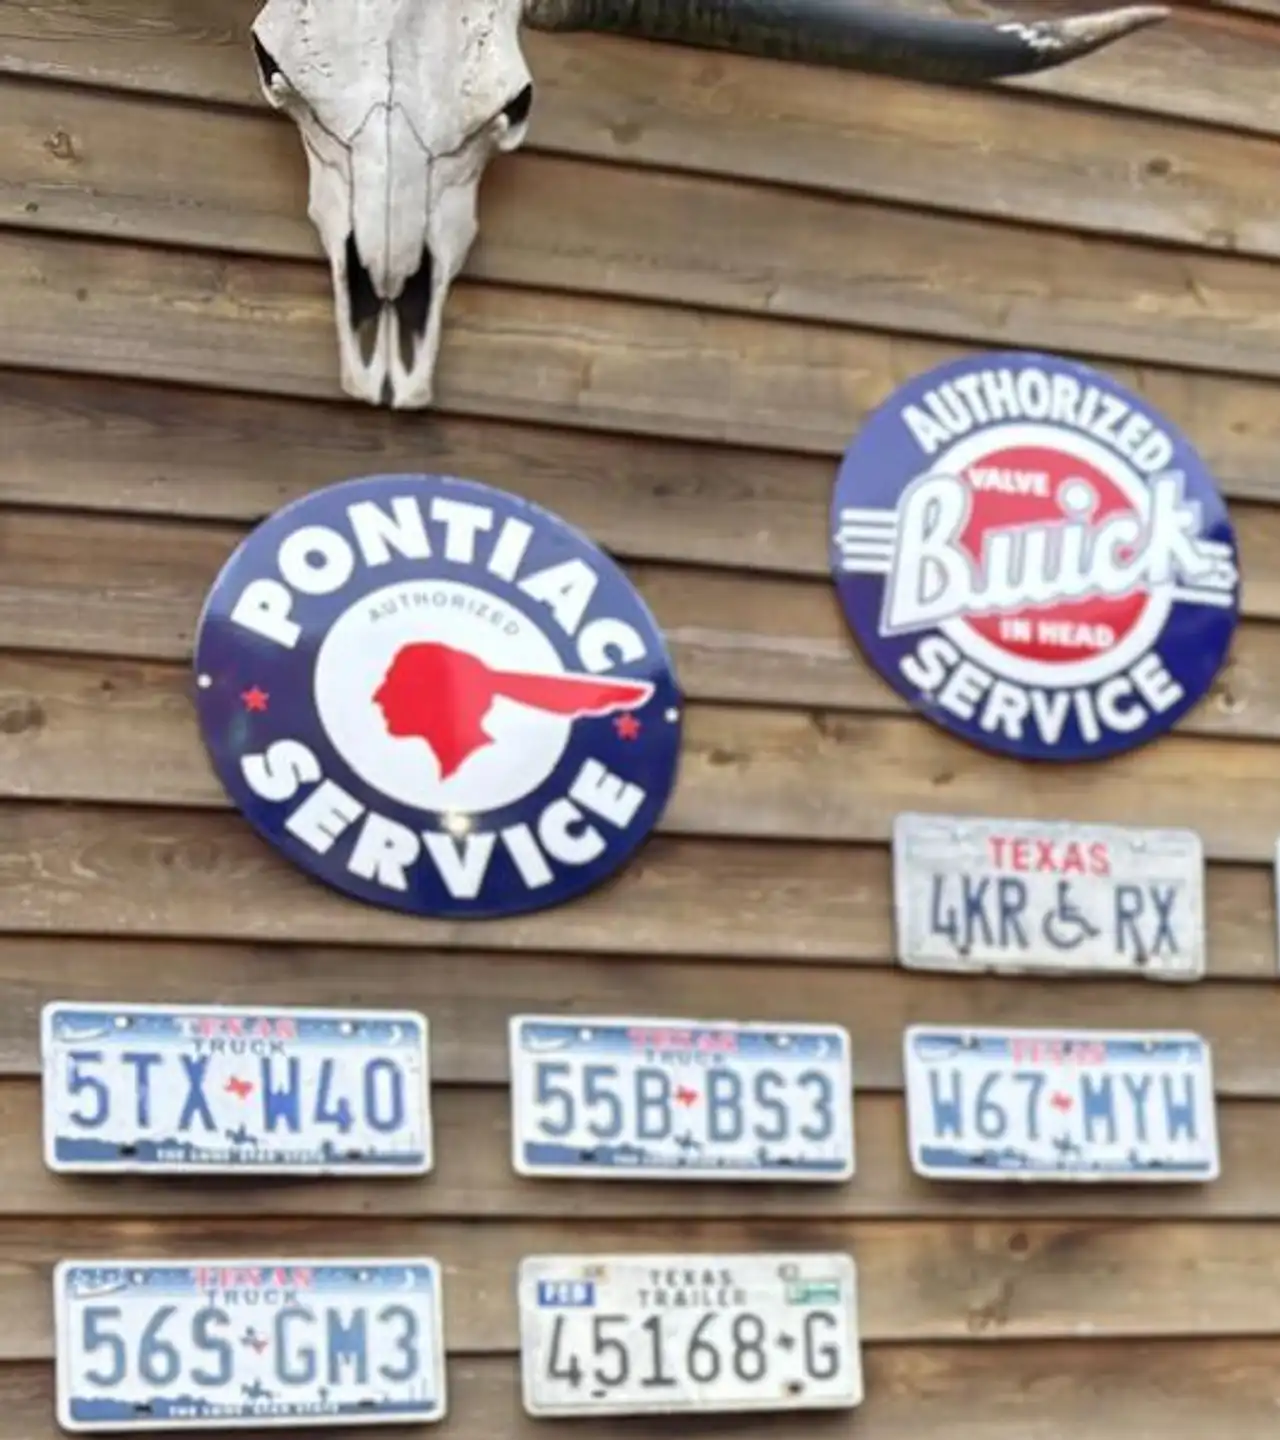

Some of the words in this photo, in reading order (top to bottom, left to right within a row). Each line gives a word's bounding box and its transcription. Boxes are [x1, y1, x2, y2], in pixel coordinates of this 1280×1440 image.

[902, 367, 1174, 474] AUTHORIZED
[969, 467, 1050, 498] VALVE
[879, 466, 1206, 637] Buick
[231, 496, 647, 673] PONTIAC
[368, 591, 521, 638] AUTHORIZED
[998, 619, 1031, 646] IN
[1038, 620, 1115, 649] HEAD
[901, 636, 1186, 745] SERVICE
[240, 739, 647, 899] SERVICE
[987, 835, 1111, 875] TEXAS
[931, 875, 1030, 951] 4KR
[1113, 882, 1180, 957] RX
[191, 1039, 287, 1056] TRUCK
[205, 1289, 302, 1306] TRUCK
[649, 1268, 735, 1288] TEXAS
